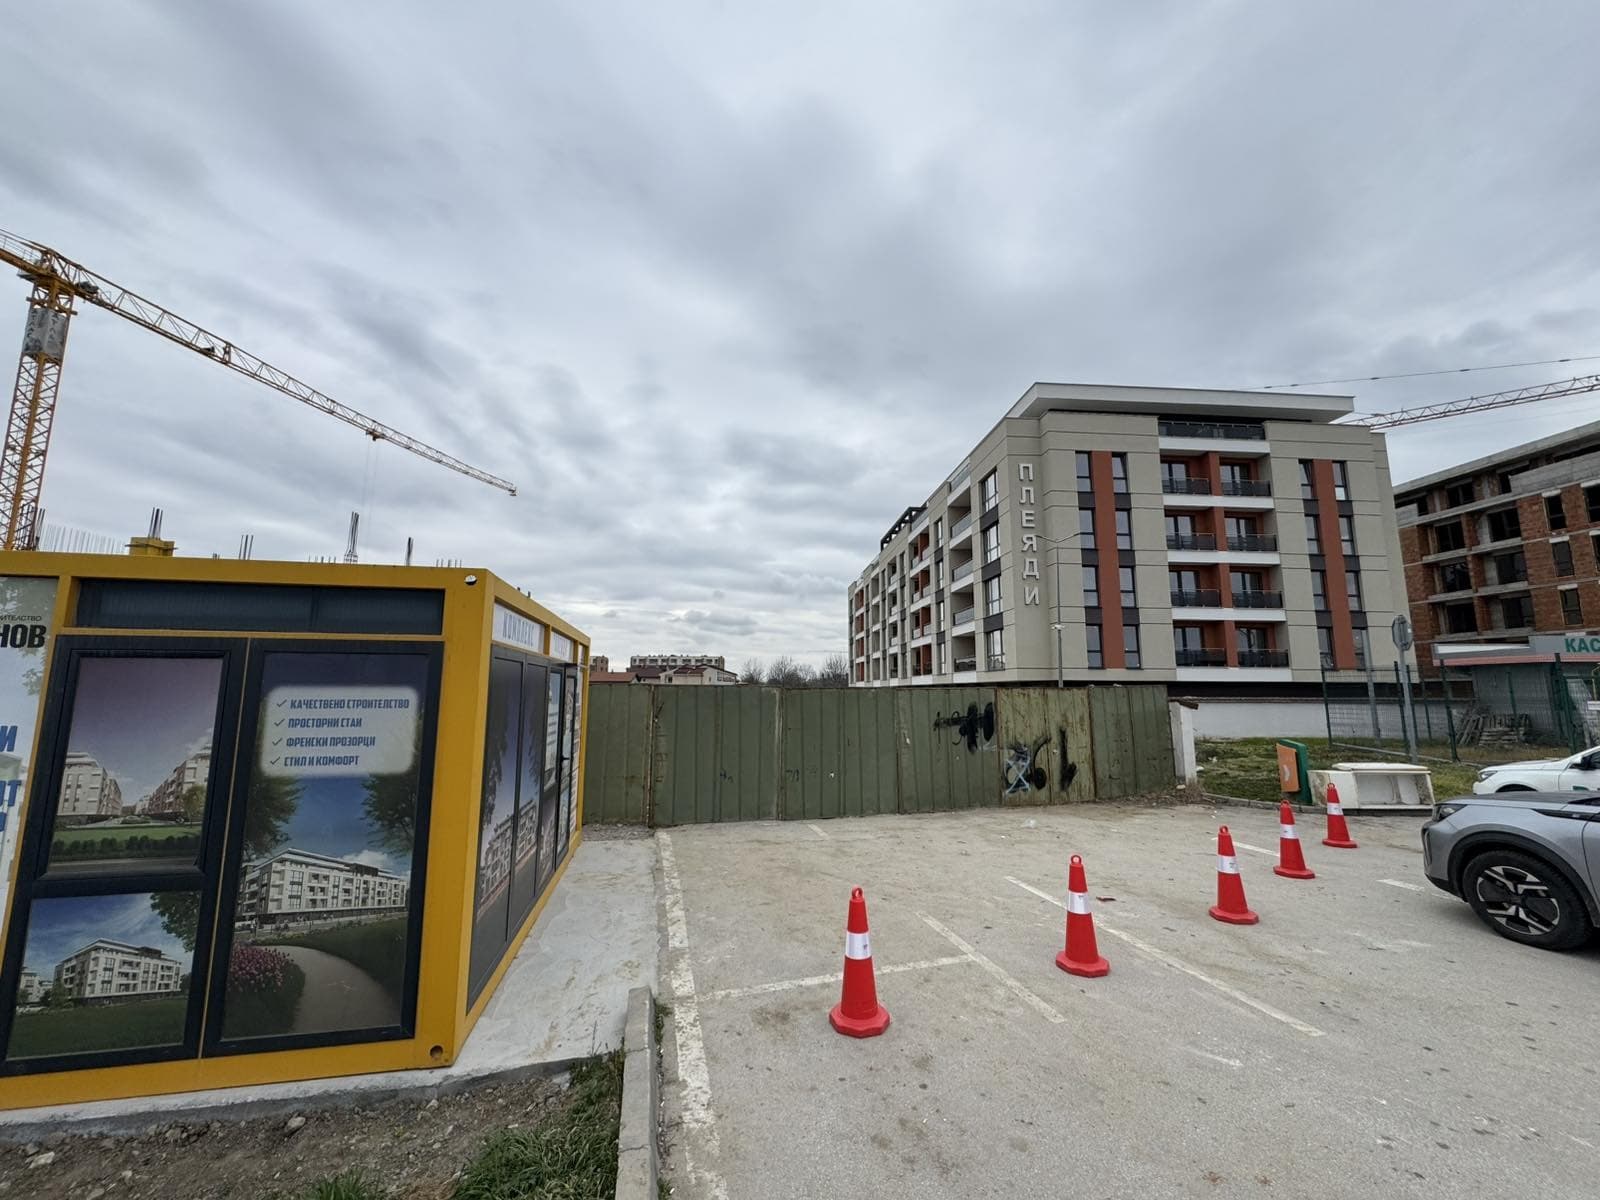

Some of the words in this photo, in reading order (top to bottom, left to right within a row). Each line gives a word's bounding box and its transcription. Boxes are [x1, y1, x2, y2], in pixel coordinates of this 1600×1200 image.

[1018, 463, 1040, 605] ПЛЕЯДИ
[290, 699, 346, 709] КАЧЕСТВЕНО
[347, 699, 410, 709] СТРОИТЕЛСТВО
[288, 718, 340, 728] ПРОСТОРНИ
[341, 718, 362, 728] СТАИ
[286, 737, 328, 747] ФРЕНСКИ
[329, 736, 376, 748] ПРОЗОРЦИ
[284, 756, 307, 767] СТИЛ
[308, 756, 315, 766] И
[315, 755, 360, 766] КОМФОРТ
